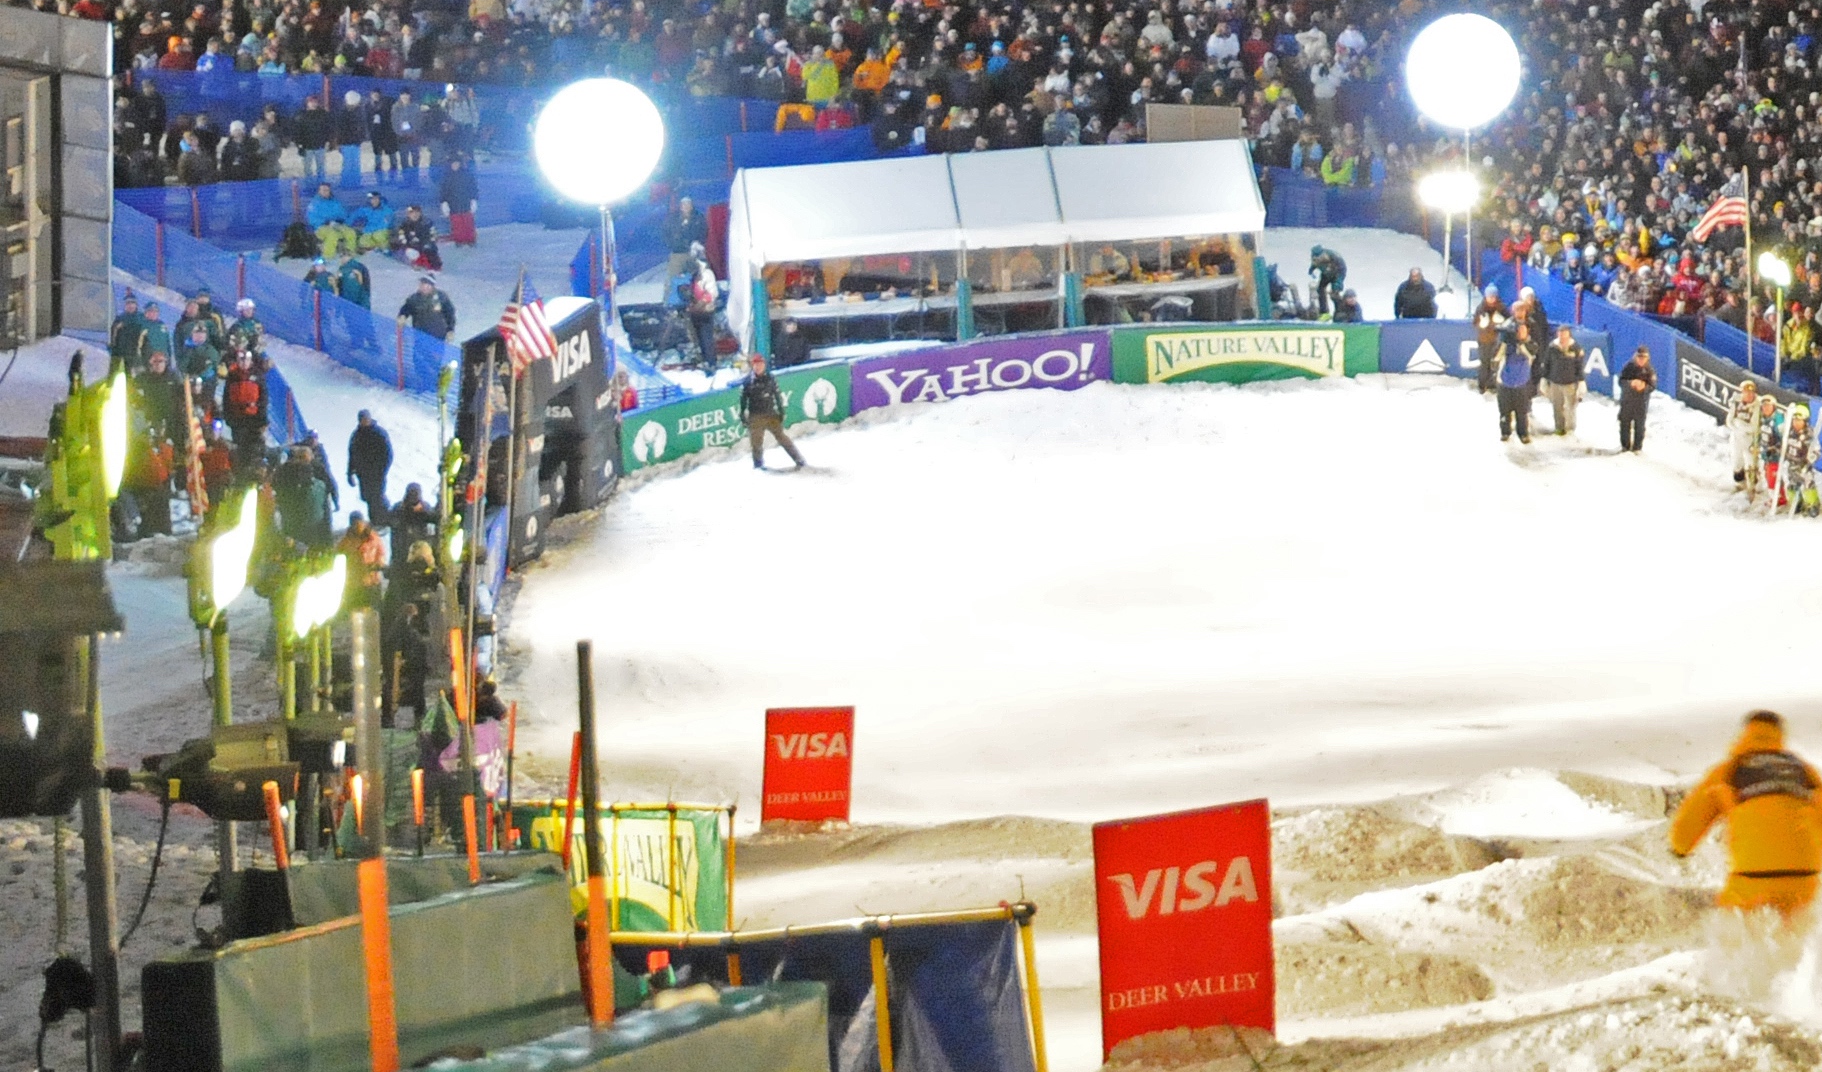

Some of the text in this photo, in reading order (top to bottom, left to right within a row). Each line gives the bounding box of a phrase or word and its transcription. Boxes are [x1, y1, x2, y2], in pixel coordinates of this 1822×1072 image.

[551, 329, 592, 384] VISA
[866, 342, 1095, 406] YAHOO!
[1154, 336, 1339, 376] NATURE VALLEY
[678, 408, 726, 435] DEER
[770, 731, 848, 760] VISA
[767, 790, 846, 804] DEER VALLEY
[1106, 856, 1259, 920] VISA
[1109, 972, 1260, 1011] DEER VALLEY
